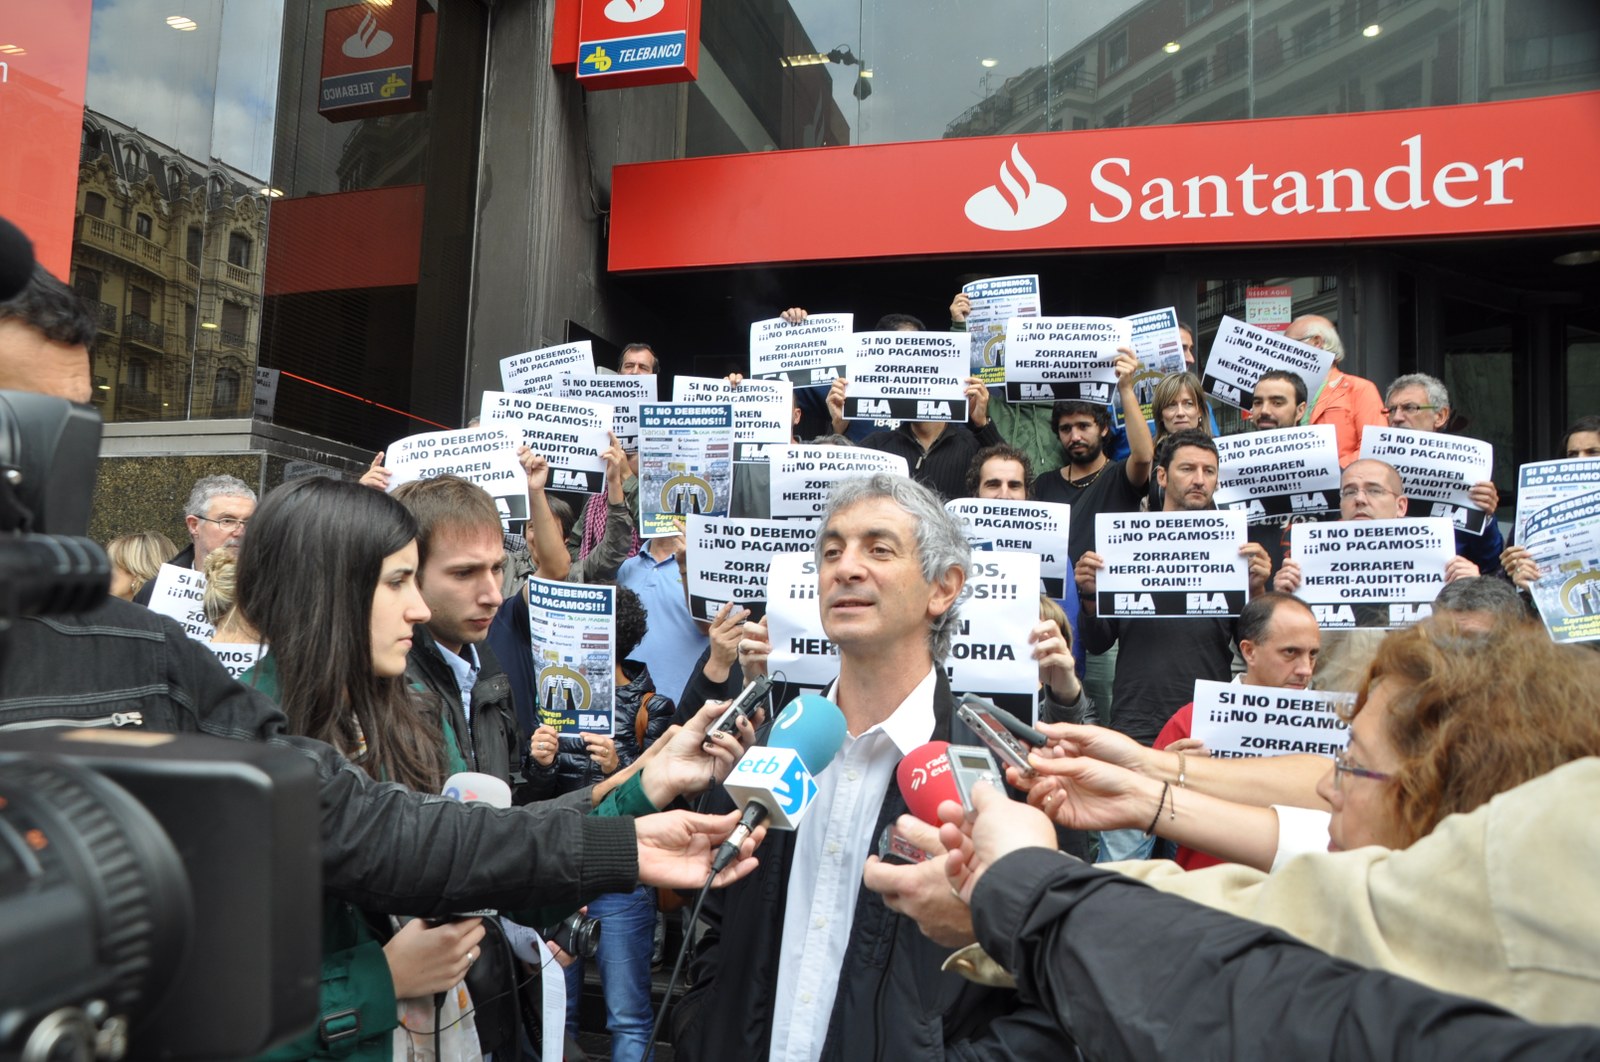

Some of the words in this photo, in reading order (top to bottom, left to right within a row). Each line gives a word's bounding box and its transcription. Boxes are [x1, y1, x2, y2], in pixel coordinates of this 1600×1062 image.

[619, 43, 682, 63] TELEBANCO
[1090, 134, 1524, 223] Santander
[991, 279, 1032, 288] DEBEMOS,
[982, 287, 1032, 296] PAGAMOS!!!
[1249, 305, 1288, 318] gratis
[763, 323, 771, 331] SI
[791, 317, 840, 328] DEBEMOS,
[1022, 322, 1034, 330] SI
[1036, 323, 1053, 331] NO
[1056, 323, 1116, 332] DEBEMOS,
[759, 332, 783, 341] ¡¡¡NO
[786, 325, 844, 337] PAGAMOS!!!
[1016, 333, 1045, 342] ¡¡¡NO
[1049, 333, 1120, 342] PAGAMOS!!!
[775, 339, 827, 351] ZORRAREN
[896, 338, 956, 347] DEBEMOS,
[1233, 326, 1244, 335] SI
[1246, 330, 1262, 342] NO
[1265, 337, 1319, 363] DEBEMOS,
[535, 347, 580, 361] DEBEMOS,
[760, 347, 844, 362] HERRI-AUDITORIA
[856, 348, 884, 358] ¡¡¡NO
[887, 348, 960, 358] PAGAMOS!!!
[1035, 349, 1098, 359] ZORRAREN
[1225, 335, 1252, 349] ¡¡¡NO
[1255, 344, 1321, 374] PAGAMOS!!!
[508, 366, 528, 378] ¡¡¡NO
[531, 354, 585, 372] PAGAMOS!!!
[781, 358, 822, 368] ORAIN!!!
[875, 365, 939, 374] ZORRAREN
[854, 375, 959, 386] HERRI-AUDITORIA
[1041, 371, 1092, 379] ORAIN!!!
[573, 379, 587, 387] NO
[590, 380, 643, 388] DEBEMOS,
[723, 385, 778, 393] DEBEMOS,
[560, 389, 582, 398] ¡¡¡NO
[585, 390, 648, 398] PAGAMOS!!!
[881, 387, 931, 396] ORAIN!!!
[1020, 383, 1054, 397] ELA
[1079, 383, 1109, 400] ELA
[1212, 380, 1241, 401] ELA
[684, 394, 712, 402] ¡¡¡NO
[499, 398, 511, 406] SI
[513, 400, 531, 409] NO
[536, 403, 598, 417] DEBEMOS,
[675, 407, 728, 415] DEBEMOS,
[857, 399, 891, 414] ELA
[917, 401, 952, 416] ELA
[492, 410, 523, 419] ¡¡¡NO
[528, 413, 602, 429] PAGAMOS!!!
[403, 442, 414, 451] SI
[417, 439, 435, 448] NO
[439, 430, 508, 445] DEBEMOS,
[1219, 442, 1230, 450] SI
[1234, 439, 1251, 449] NO
[1255, 431, 1319, 446] DEBEMOS,
[1379, 433, 1392, 442] SI
[1396, 435, 1415, 445] NO
[1419, 438, 1482, 456] DEBEMOS,
[396, 450, 429, 464] ¡¡¡NO
[434, 441, 514, 458] PAGAMOS!!!
[1249, 439, 1326, 458] PAGAMOS!!!
[788, 451, 799, 459] SI
[804, 451, 822, 459] NO
[827, 451, 892, 463] DEBEMOS,
[1372, 445, 1404, 456] ¡¡¡NO
[1410, 448, 1486, 467] PAGAMOS!!!
[419, 461, 491, 478] ZORRAREN
[782, 462, 815, 472] ¡¡¡NO
[819, 462, 898, 472] PAGAMOS!!!
[1238, 460, 1305, 476] ZORRAREN
[1526, 468, 1537, 476] SI
[1540, 466, 1557, 474] NO
[552, 470, 588, 487] ELA
[1220, 467, 1329, 489] HERRI-AUDITORIA
[1527, 477, 1544, 485] NO
[1249, 482, 1302, 495] ORAIN!!!
[1290, 492, 1328, 509] ELA
[960, 505, 978, 514] NO
[983, 506, 1052, 519] DEBEMOS,
[1535, 509, 1549, 519] NO
[704, 524, 717, 534] SI
[723, 526, 744, 536] NO
[975, 518, 1058, 531] PAGAMOS!!!
[1113, 520, 1125, 529] SI
[1131, 520, 1151, 529] NO
[1155, 518, 1228, 528] DEBEMOS,
[1527, 524, 1539, 536] NO
[1108, 532, 1143, 544] ¡¡¡NO
[1148, 531, 1235, 541] PAGAMOS!!!
[1309, 529, 1322, 538] SI
[1327, 529, 1349, 538] NO
[1354, 525, 1434, 537] DEBEMOS,
[699, 538, 736, 549] ¡¡¡NO
[1304, 542, 1341, 554] ¡¡¡NO
[1346, 539, 1442, 551] PAGAMOS!!!
[1133, 552, 1210, 561] ZORRAREN
[1109, 564, 1235, 574] HERRI-AUDITORIA
[1330, 561, 1414, 572] ZORRAREN
[178, 574, 191, 584] SI
[1141, 577, 1202, 586] ORAIN!!!
[1305, 574, 1443, 585] HERRI-AUDITORIA
[168, 587, 204, 601] ¡¡¡NO
[531, 583, 536, 591] SI
[538, 585, 549, 594] NO
[551, 587, 606, 601] DEBEMOS,
[1340, 588, 1406, 598] ORAIN!!!
[532, 595, 540, 604] NO
[542, 598, 605, 611] PAGAMOS!!!
[1114, 593, 1155, 610] ELA
[1186, 593, 1229, 610] ELA
[1219, 692, 1236, 704] SI
[1242, 695, 1270, 707] NO
[579, 715, 609, 726] ELA
[1210, 710, 1258, 723] ¡¡¡NO
[1240, 736, 1344, 754] ZORRAREN
[738, 756, 780, 775] etb
